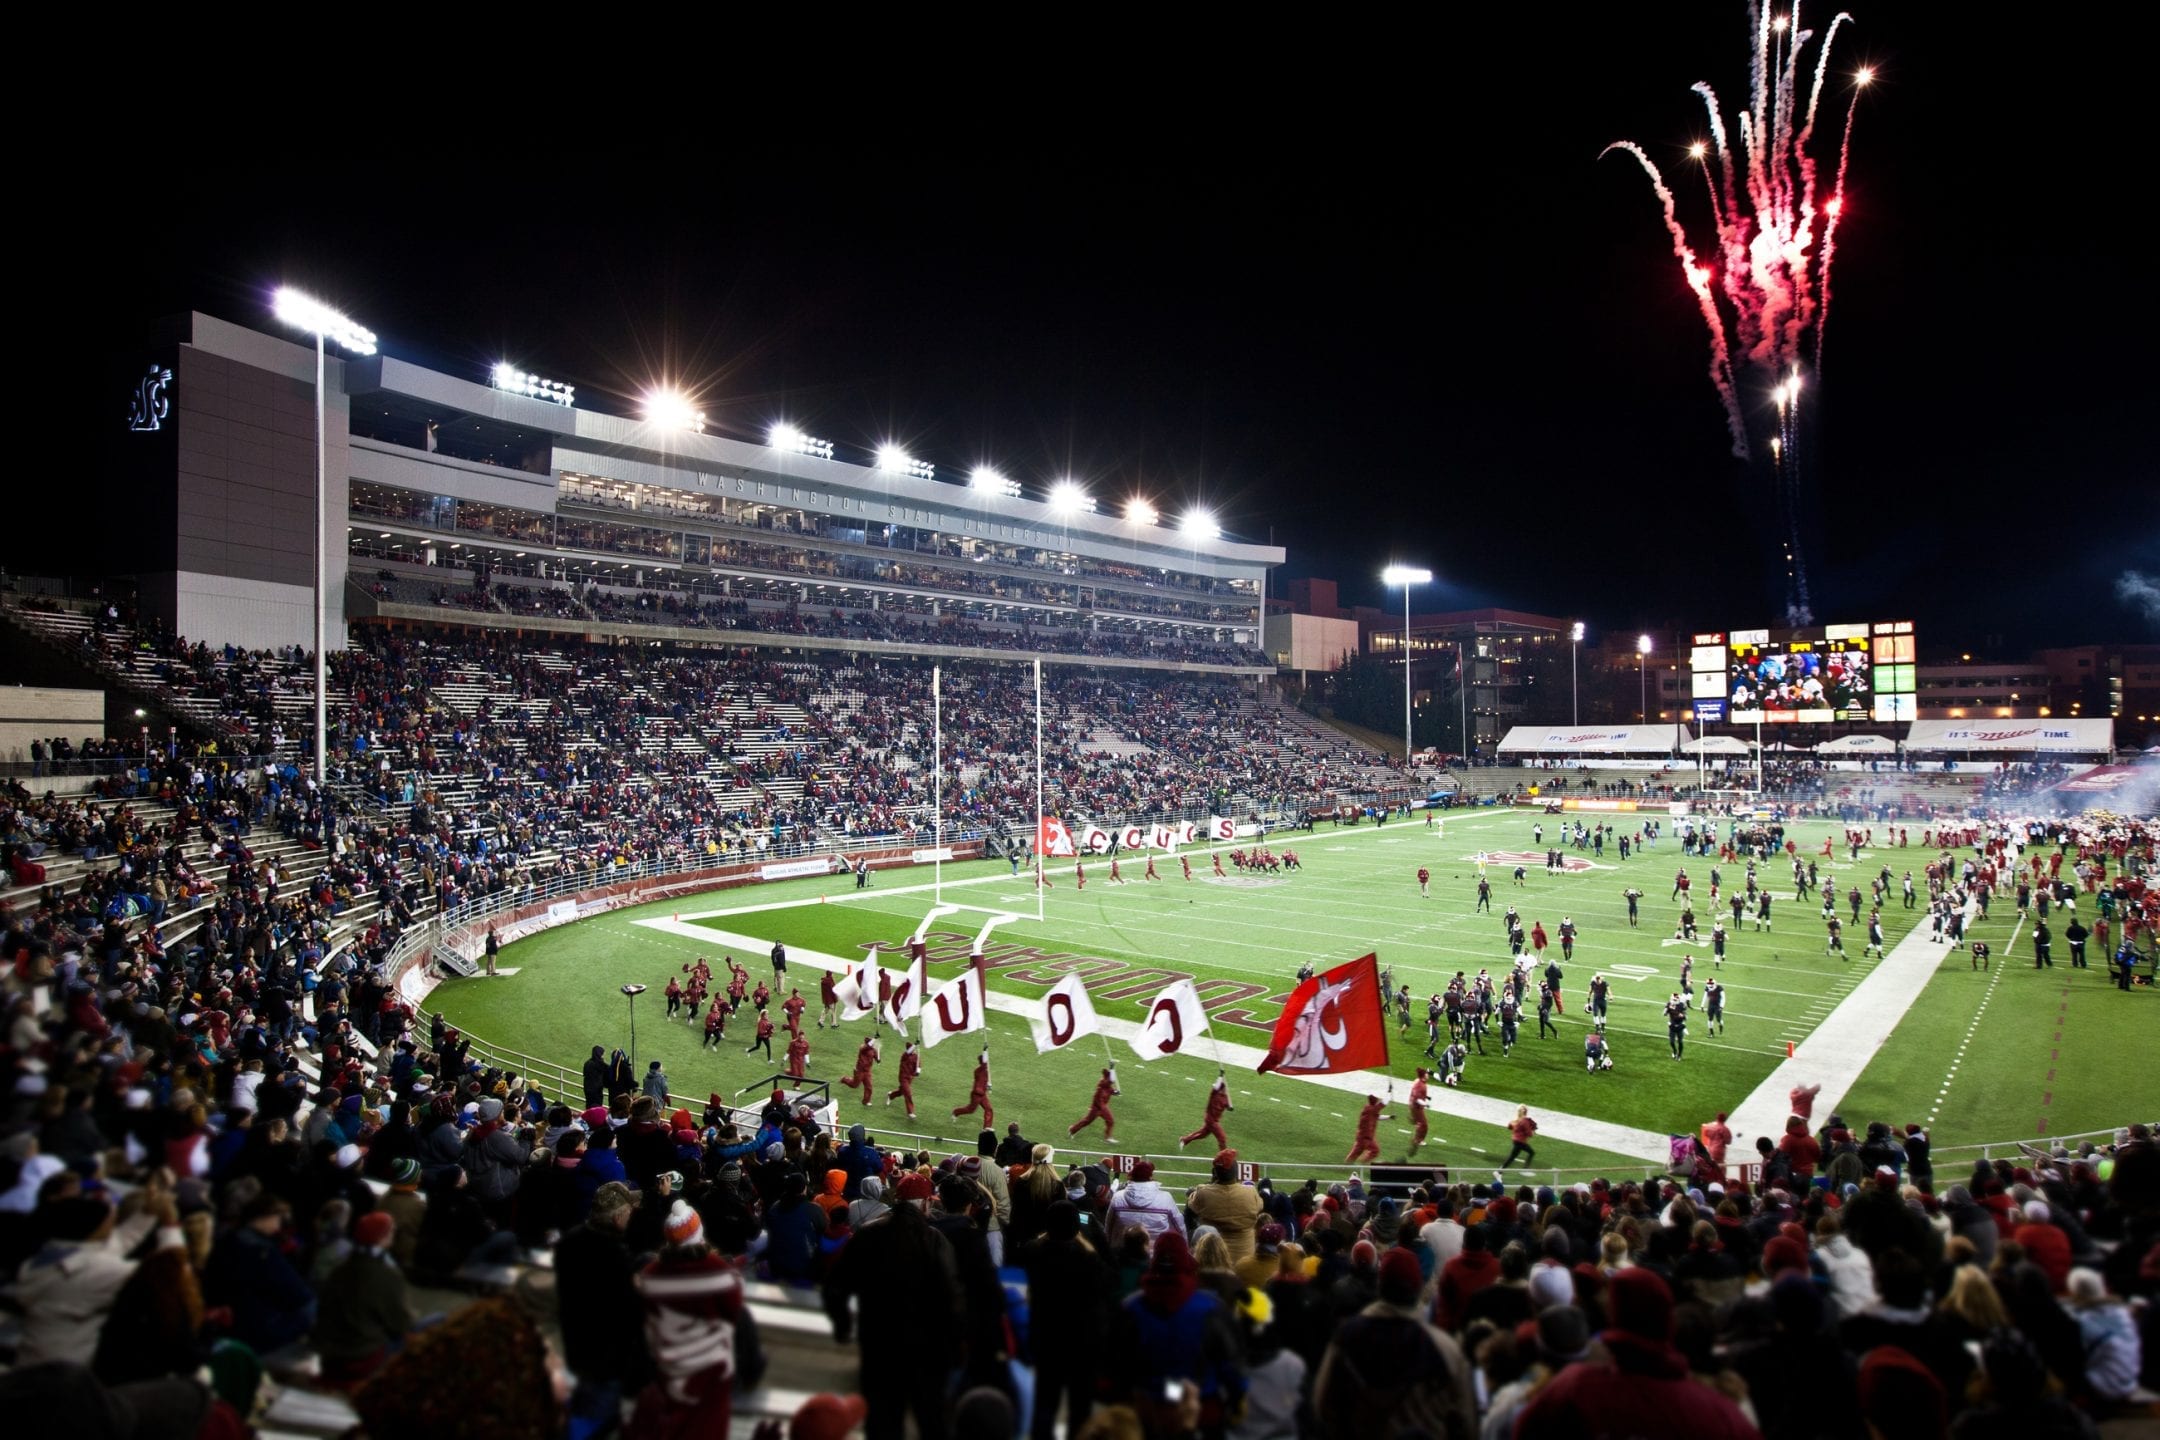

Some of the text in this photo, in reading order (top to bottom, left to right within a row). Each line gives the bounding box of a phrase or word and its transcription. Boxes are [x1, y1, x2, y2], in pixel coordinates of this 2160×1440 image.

[697, 472, 1074, 547] WASHINGTON STATE UNIVERSITY
[1948, 727, 2070, 742] IT'S Miller TIME
[1156, 828, 1170, 848] U
[1219, 820, 1233, 838] S
[934, 979, 968, 1032] U
[1120, 1156, 1134, 1173] 18
[1238, 1163, 1253, 1181] 19
